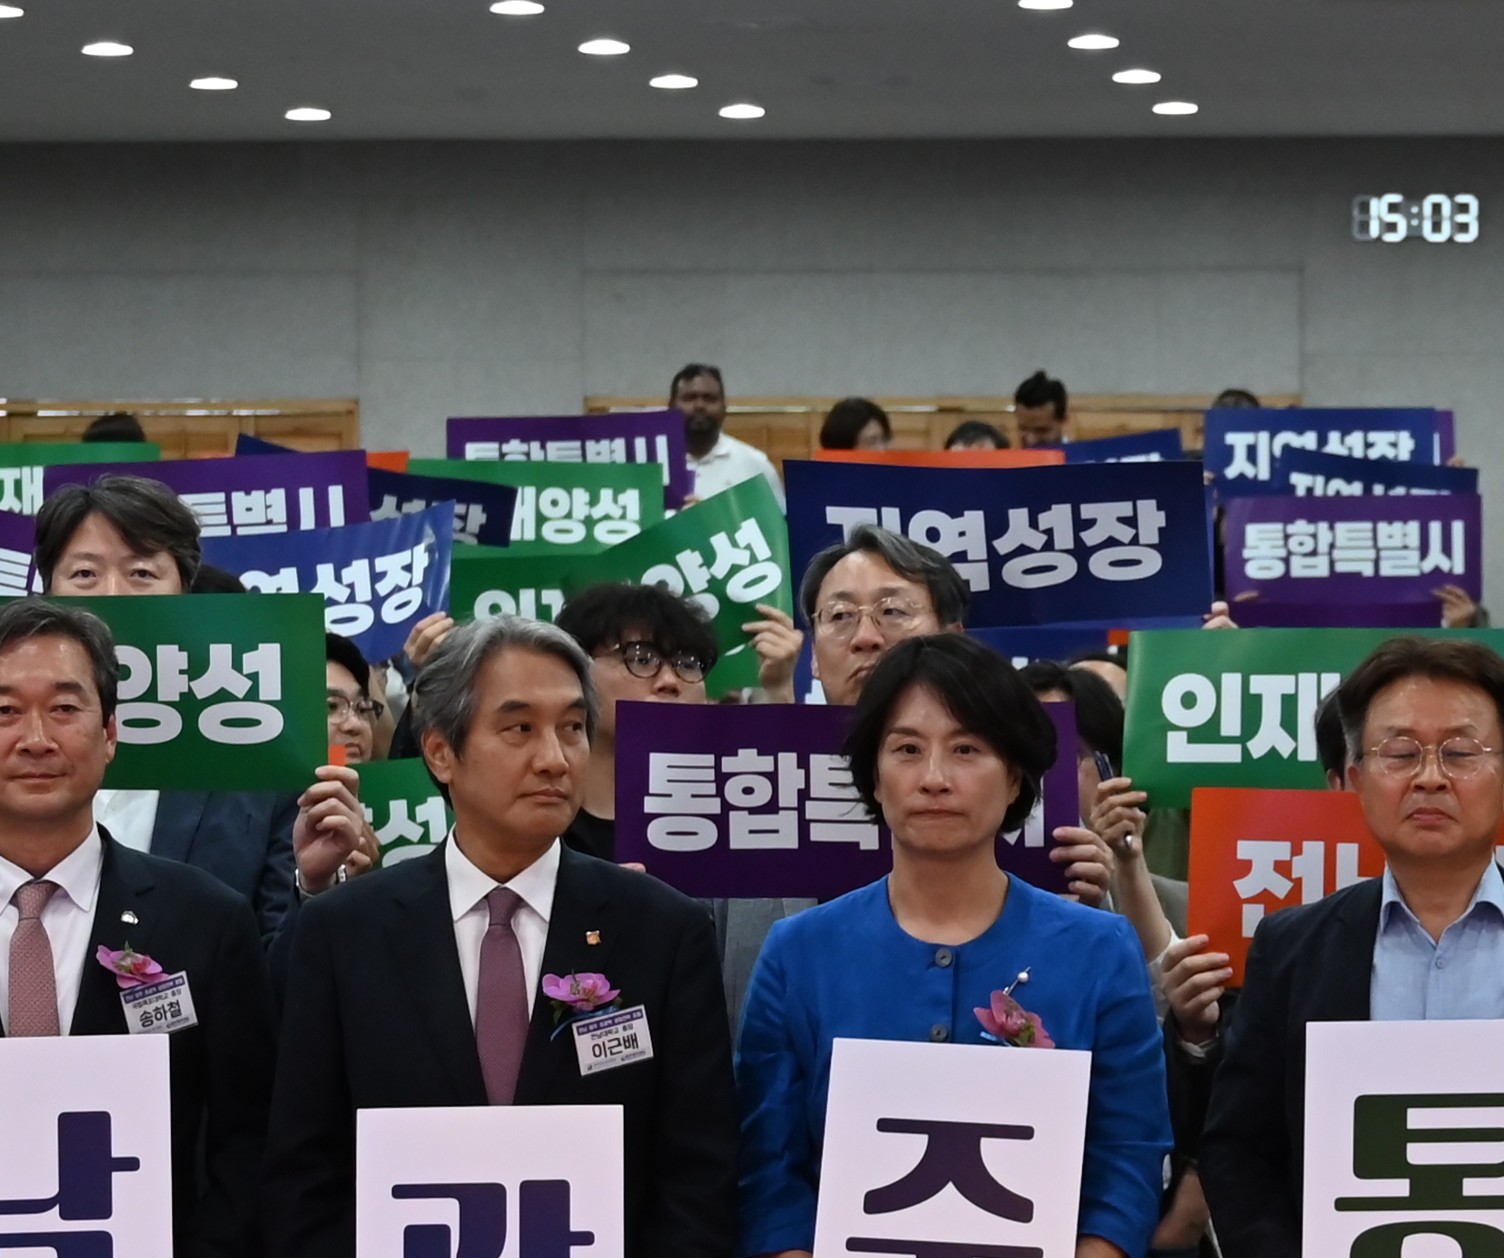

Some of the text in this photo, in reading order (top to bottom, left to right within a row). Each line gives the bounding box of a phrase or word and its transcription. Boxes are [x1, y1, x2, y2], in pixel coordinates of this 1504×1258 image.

[1369, 193, 1479, 242] 15:03
[641, 517, 782, 621] 양성
[1243, 519, 1465, 580] 통합특별시
[1162, 672, 1341, 764] 인재
[592, 1033, 639, 1058] 이근배
